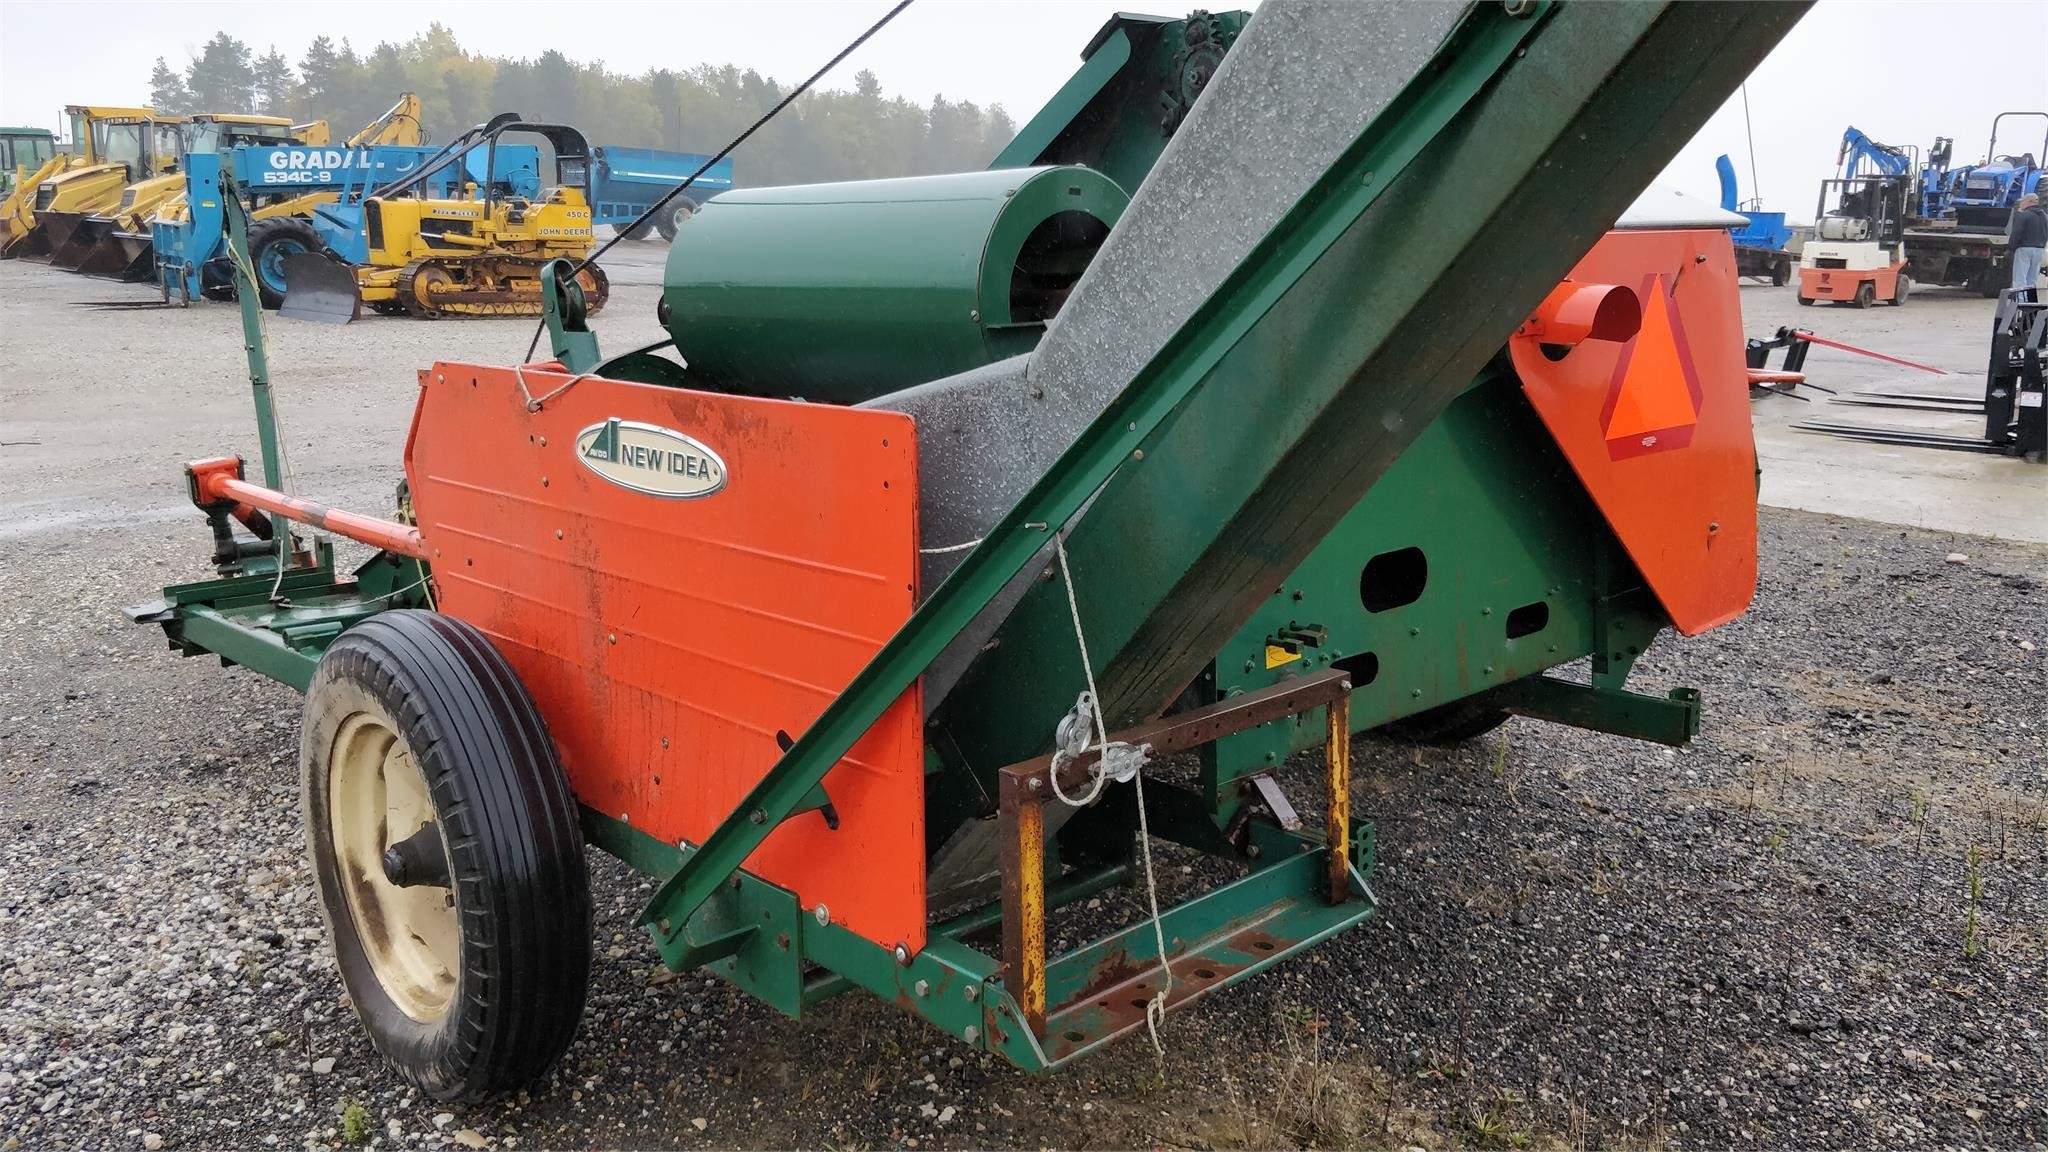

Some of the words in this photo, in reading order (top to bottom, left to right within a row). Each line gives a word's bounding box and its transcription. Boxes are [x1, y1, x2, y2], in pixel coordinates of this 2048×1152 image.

[263, 171, 332, 183] 534C-9
[583, 211, 589, 219] C
[563, 228, 590, 236] DEERE
[621, 443, 665, 472] NEW
[667, 450, 712, 482] IDEA
